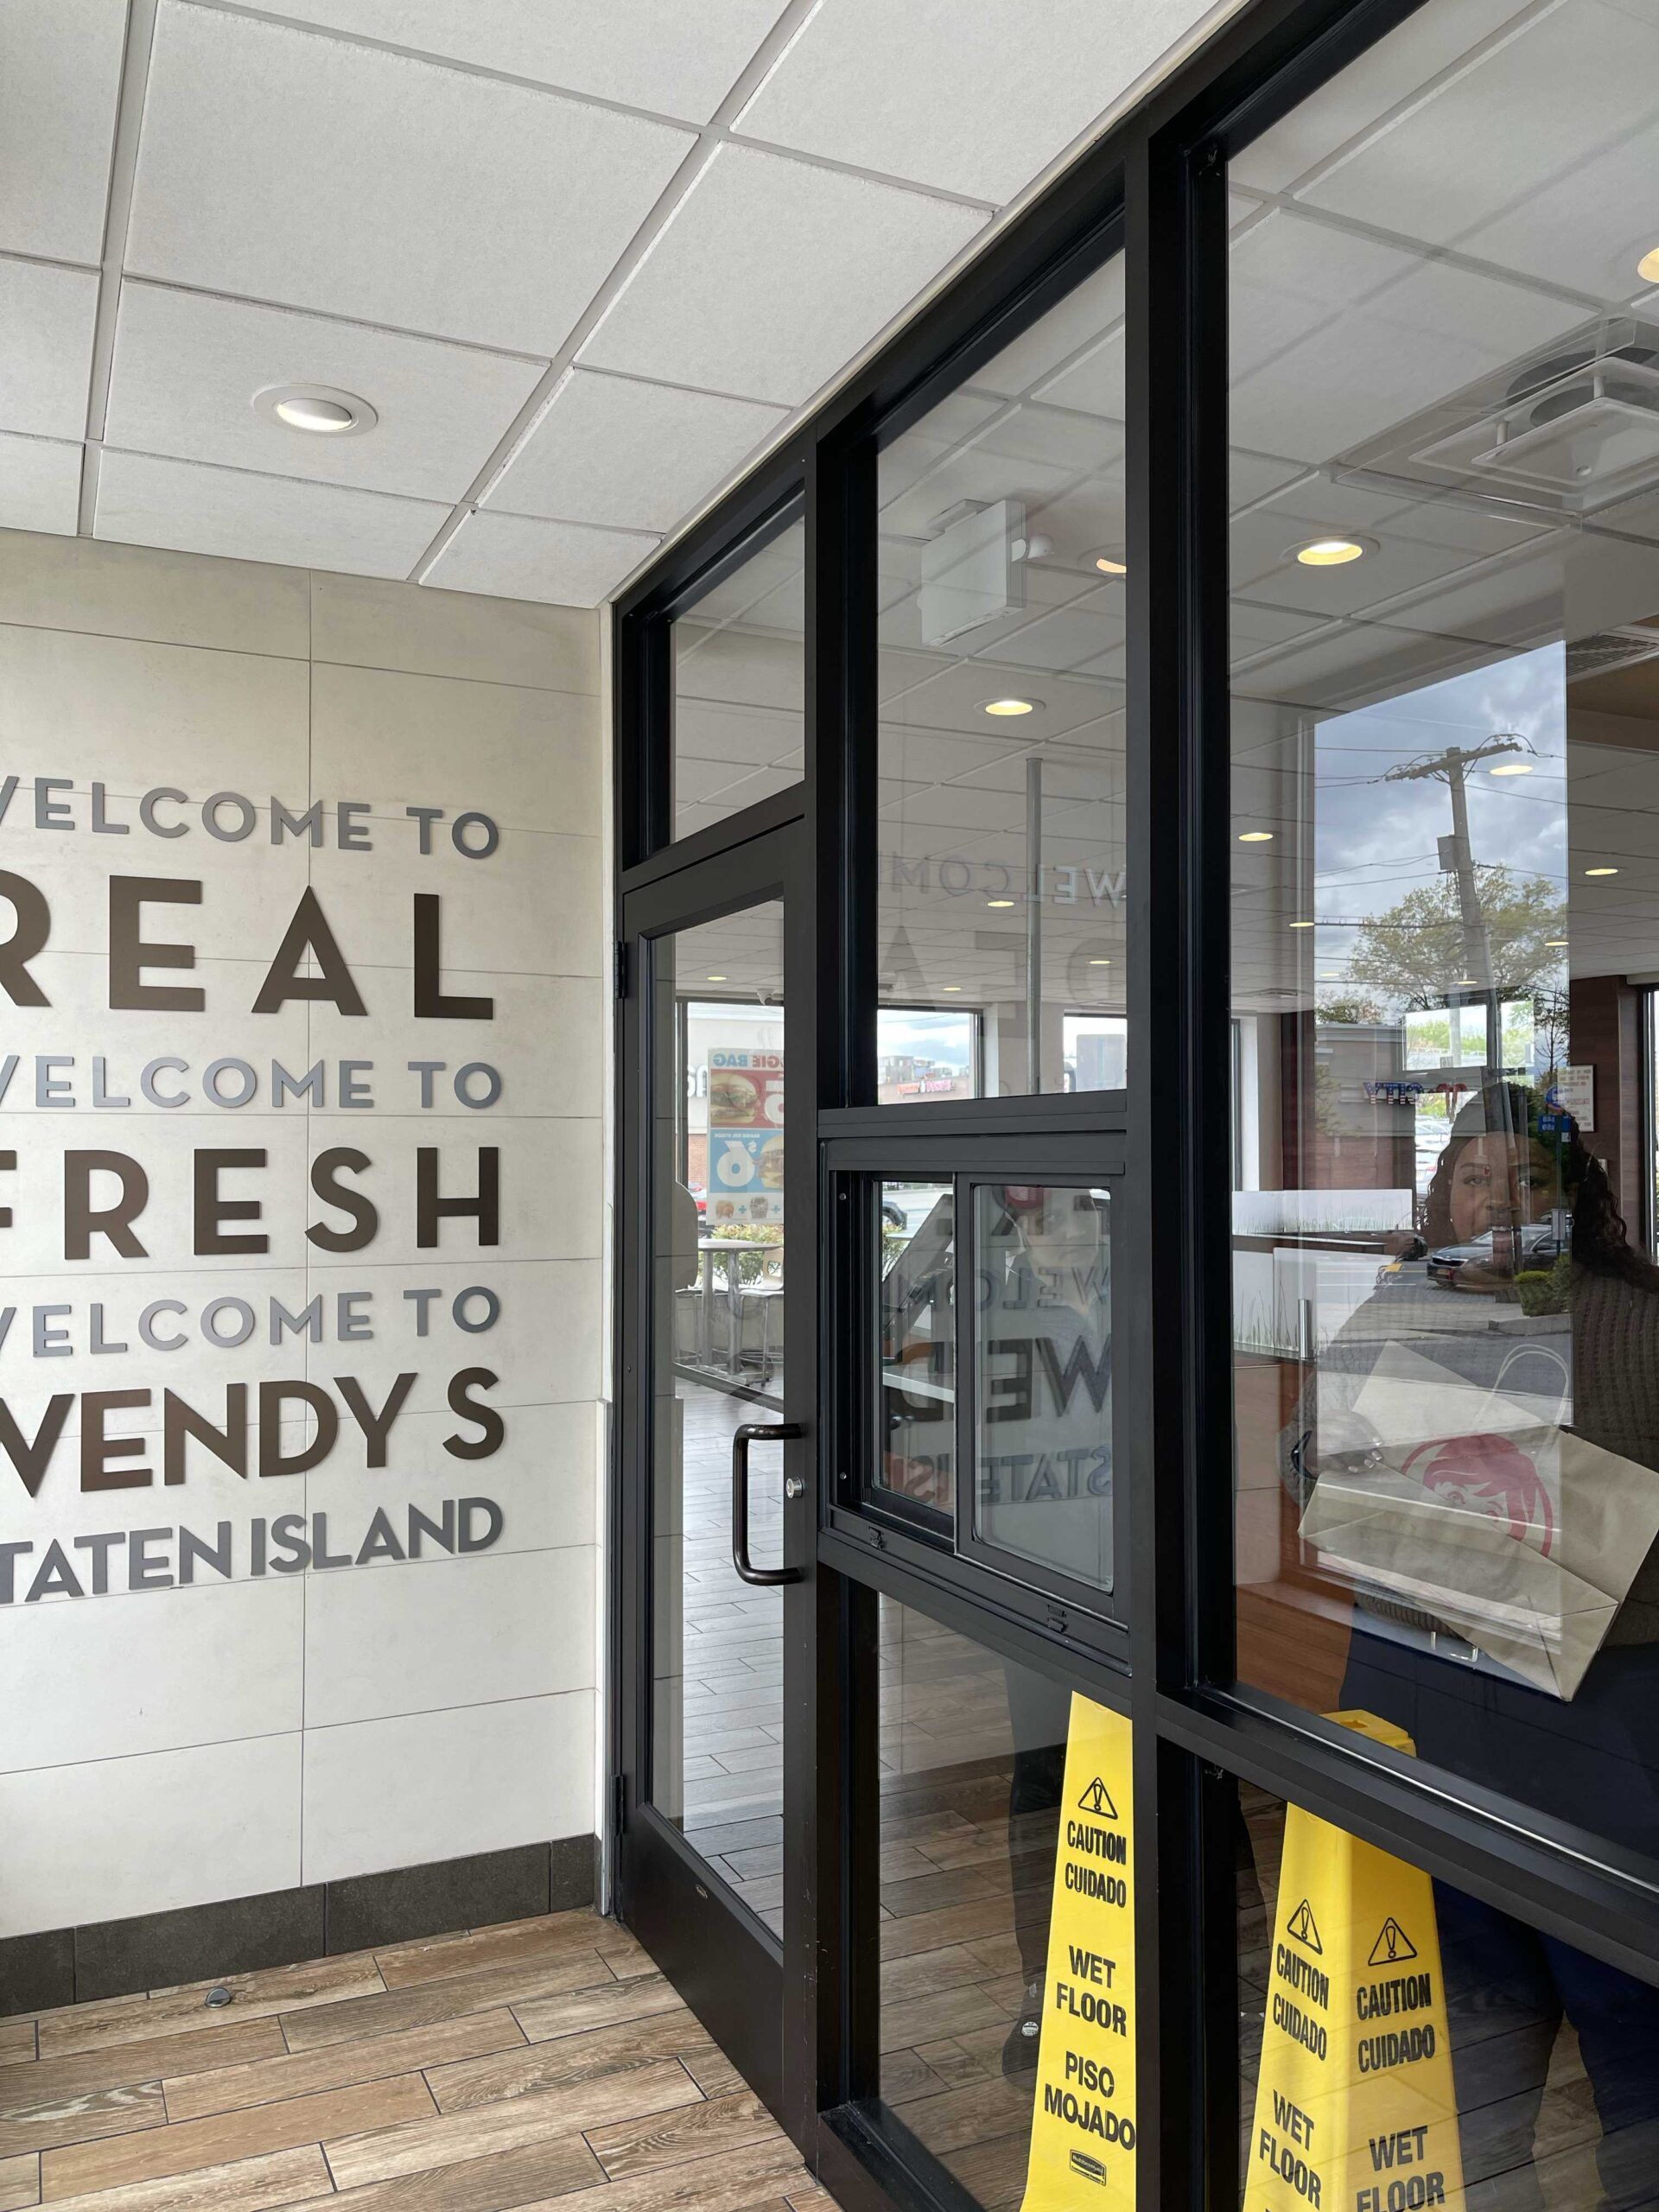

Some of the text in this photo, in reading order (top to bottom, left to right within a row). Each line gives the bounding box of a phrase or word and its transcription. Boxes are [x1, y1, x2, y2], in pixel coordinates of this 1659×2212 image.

[407, 807, 500, 860] TO
[0, 870, 494, 1020] REAL
[408, 1062, 503, 1109] TO
[0, 1147, 499, 1261] RESH
[404, 1287, 502, 1338] TO
[251, 1497, 505, 1577] ISLAND
[1066, 1820, 1127, 1866] CAUTION
[1065, 1862, 1127, 1909] CUIDADO
[1068, 1945, 1116, 1989] WET
[1276, 1942, 1329, 2012] CAUTION
[1056, 1983, 1127, 2037] FLOOR
[1357, 1973, 1432, 2020] CAUTION
[1273, 1992, 1328, 2062] CUIDADO
[1358, 2024, 1435, 2073] CUIDADO
[1064, 2050, 1115, 2099] PISO
[1044, 2082, 1136, 2151] MOJADO
[1272, 2090, 1315, 2152] WET
[1260, 2127, 1322, 2209] FLOOR
[1370, 2126, 1428, 2172] WET
[1357, 2170, 1446, 2212] FLOOR
